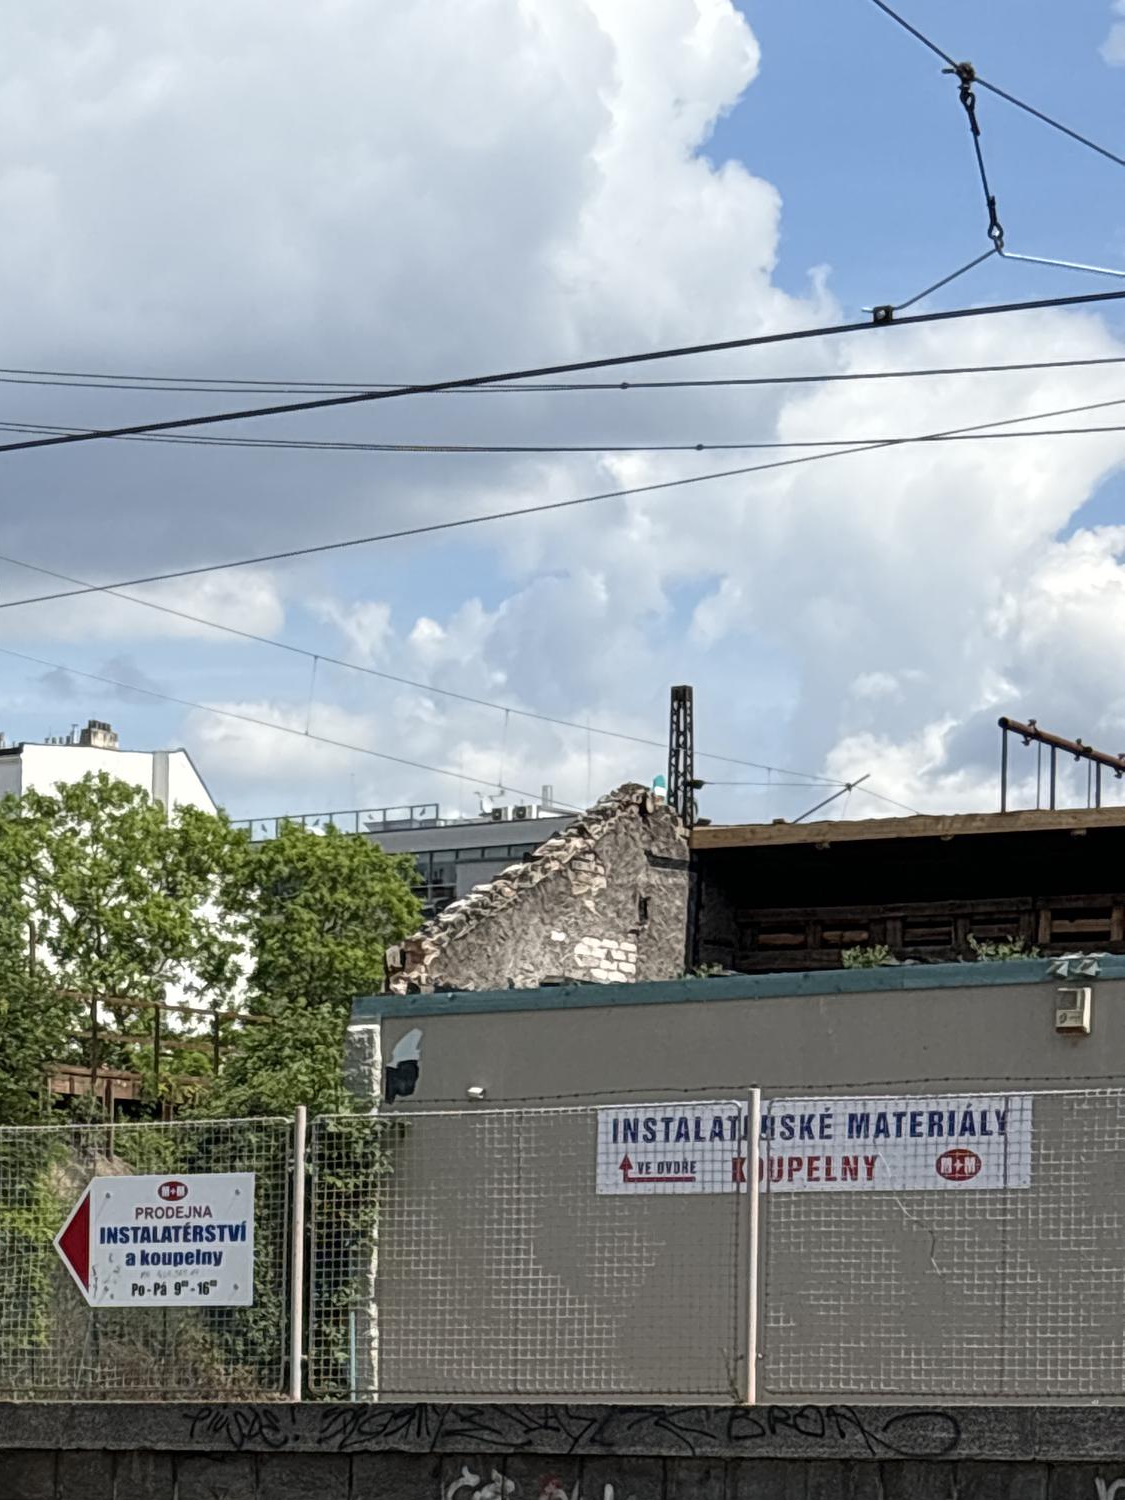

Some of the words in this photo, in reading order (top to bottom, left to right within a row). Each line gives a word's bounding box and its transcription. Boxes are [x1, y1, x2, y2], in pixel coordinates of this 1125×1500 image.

[847, 1103, 1007, 1140] MATERIÁLY
[637, 1161, 652, 1175] VE
[939, 1156, 977, 1174] M+M
[134, 1205, 213, 1221] PRODEJNA
[99, 1221, 247, 1244] INSTALATÉRSTVÍ
[125, 1252, 136, 1266] a
[140, 1250, 224, 1268] koupelny
